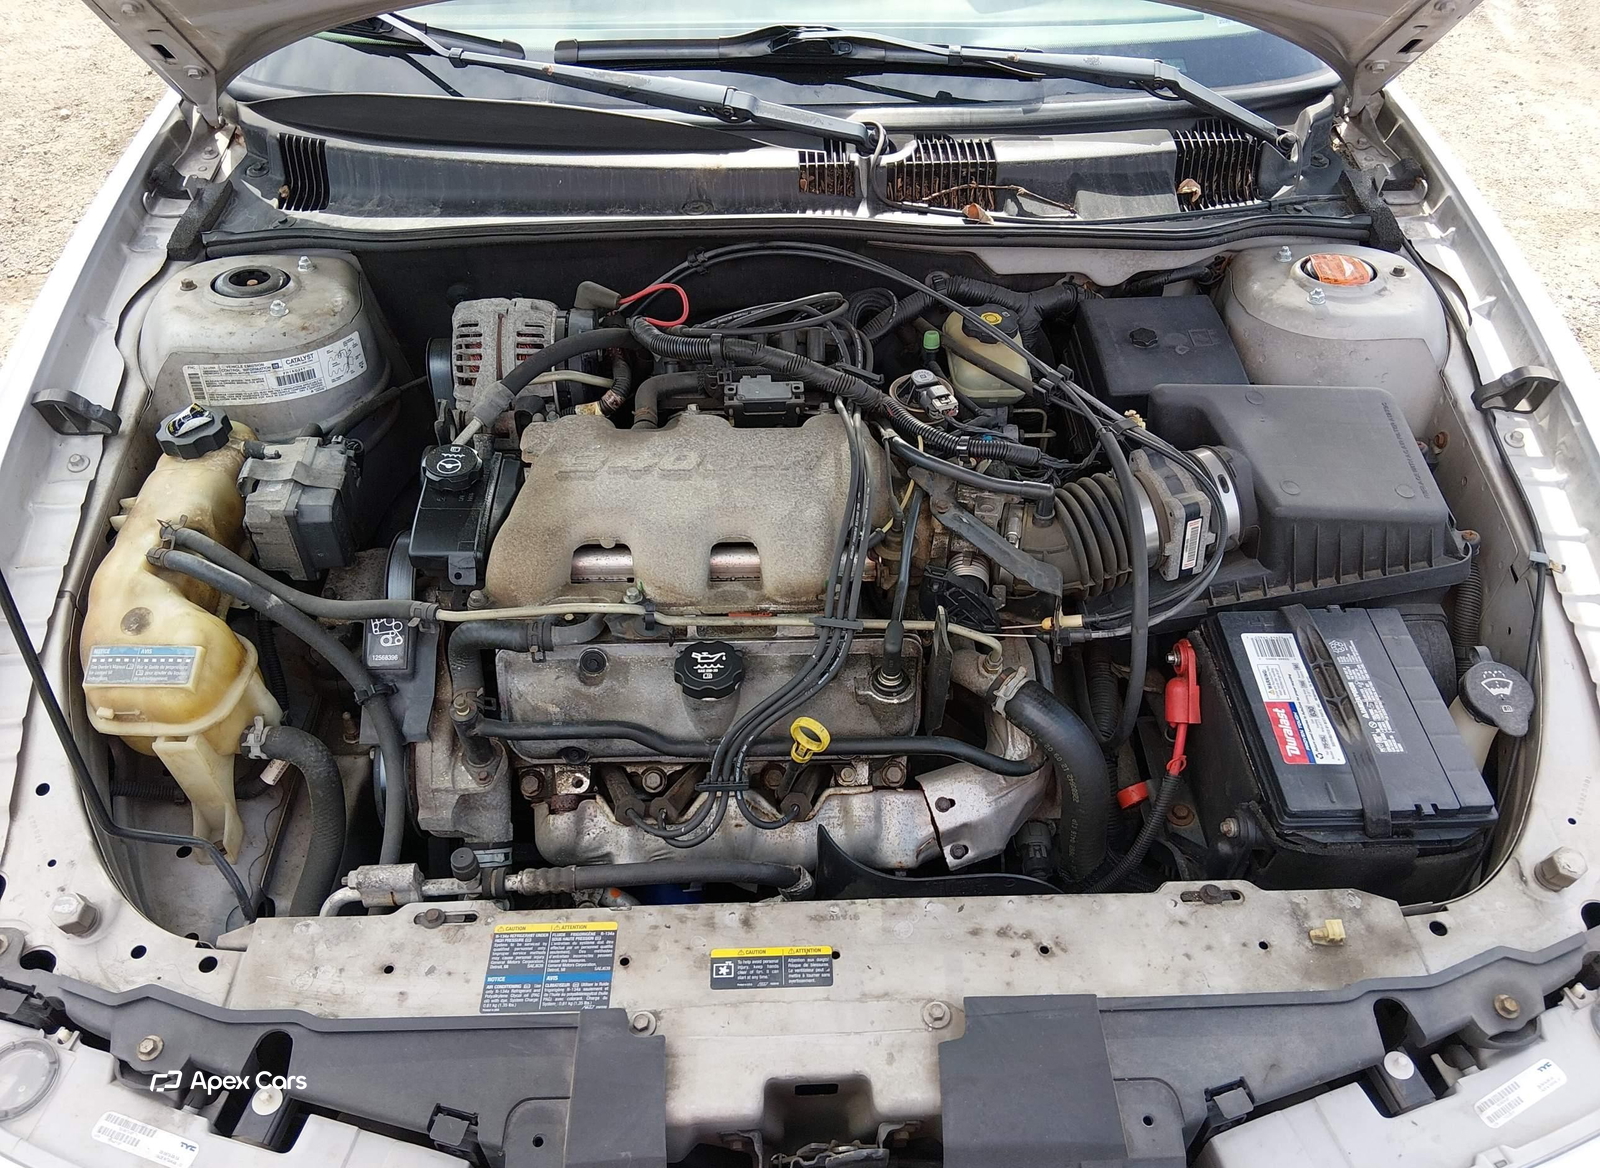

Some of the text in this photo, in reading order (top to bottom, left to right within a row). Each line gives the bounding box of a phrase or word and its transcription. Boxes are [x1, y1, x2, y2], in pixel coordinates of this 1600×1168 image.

[286, 353, 314, 364] CATALYST
[1272, 708, 1300, 756] Duralast
[180, 1142, 196, 1152] TYC
